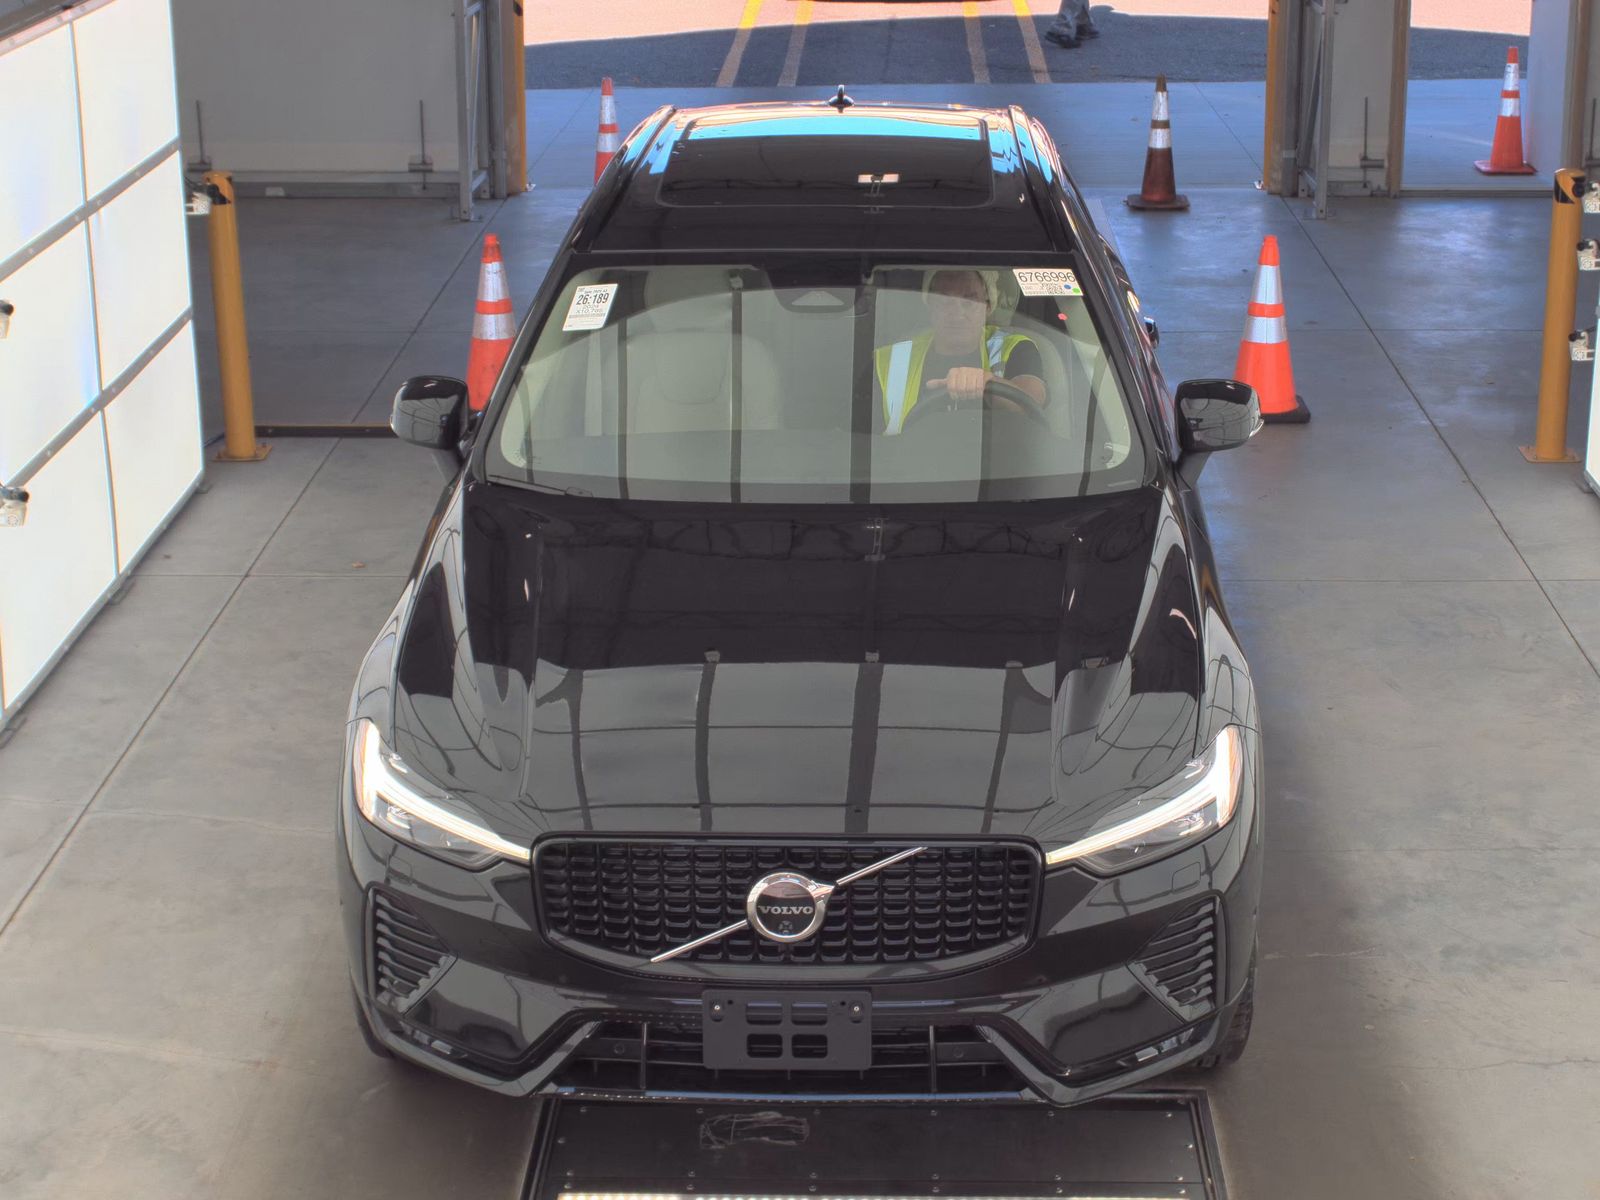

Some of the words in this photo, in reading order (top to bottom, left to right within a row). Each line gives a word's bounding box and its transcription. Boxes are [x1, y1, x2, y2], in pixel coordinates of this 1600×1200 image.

[1018, 271, 1076, 283] 6766996
[576, 293, 610, 305] 26:189
[757, 905, 814, 915] VOLVO
